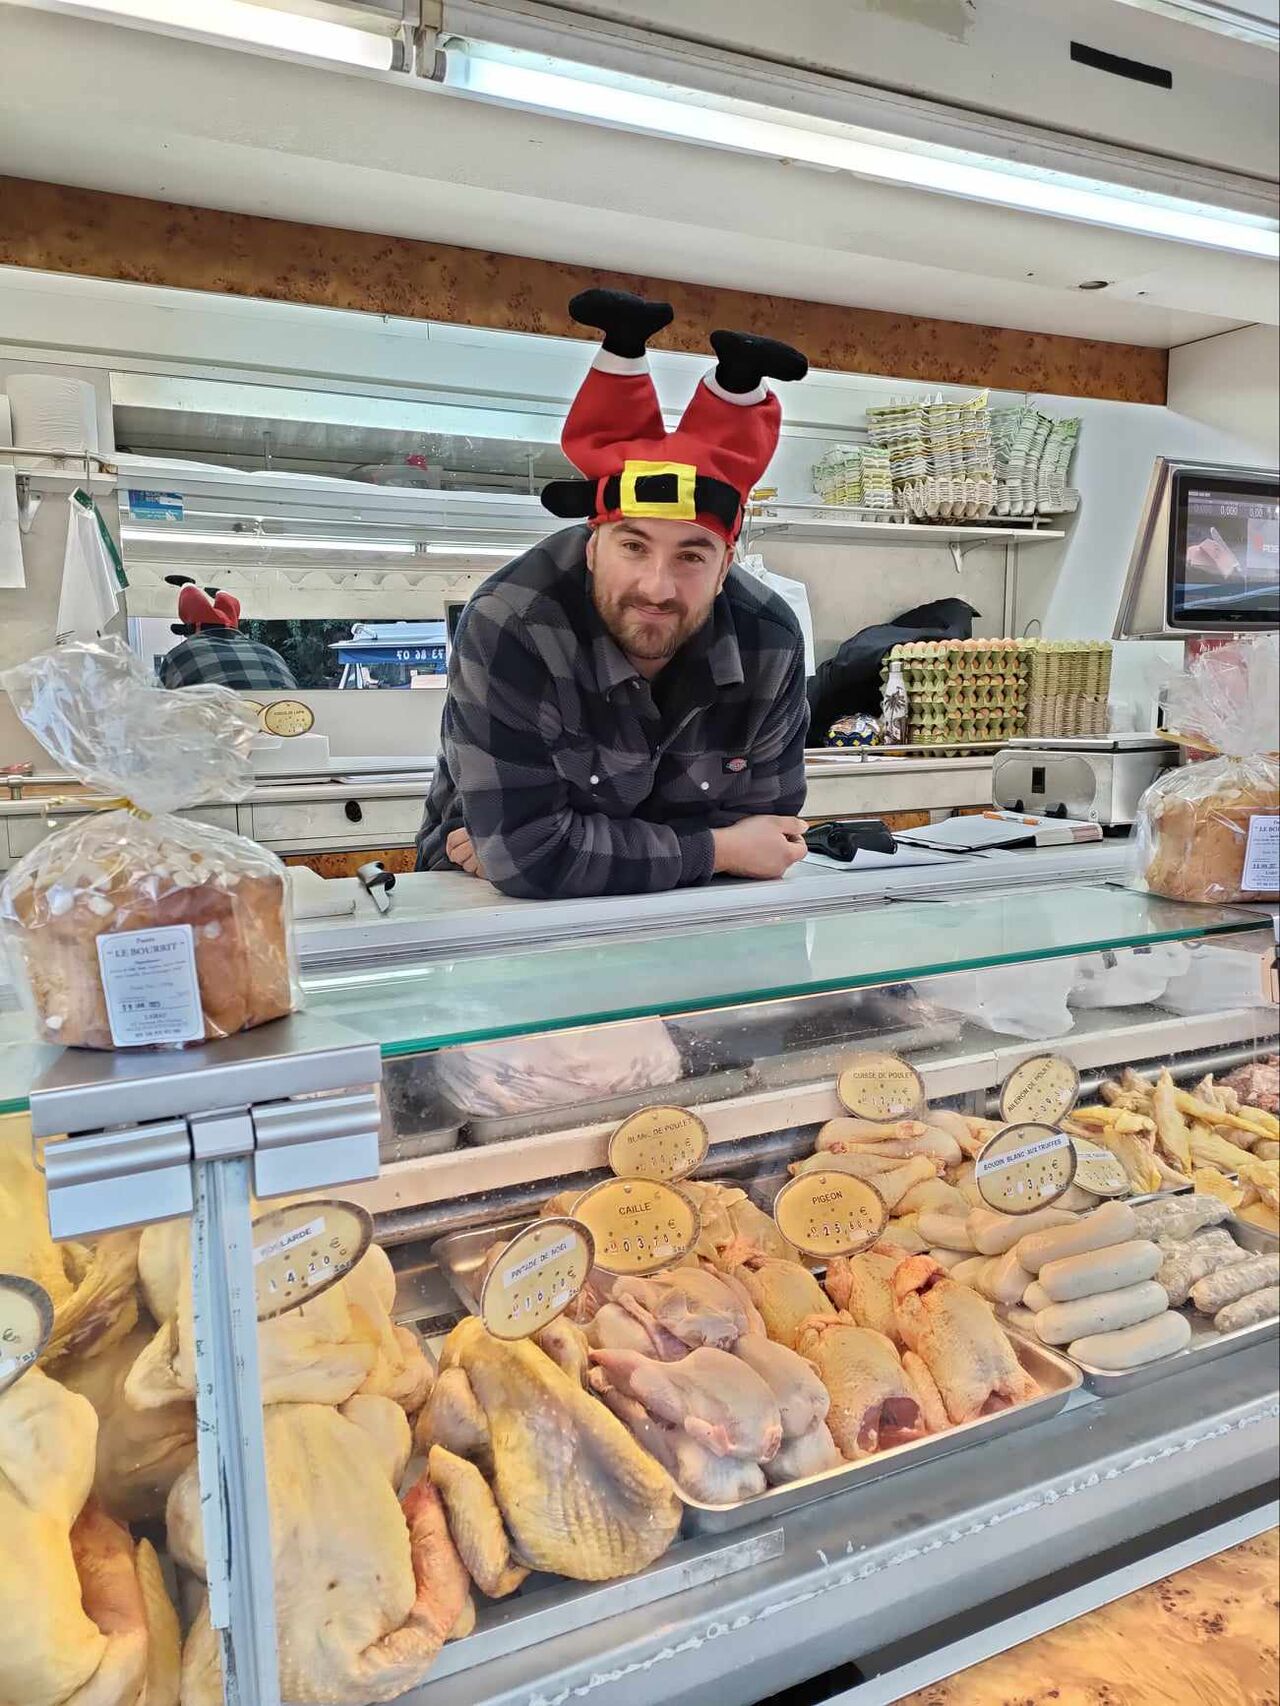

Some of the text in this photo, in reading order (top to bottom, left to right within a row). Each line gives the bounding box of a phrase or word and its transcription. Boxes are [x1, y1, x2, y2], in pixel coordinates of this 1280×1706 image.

[983, 1158, 1005, 1171] BOUDIN
[1006, 1151, 1025, 1163] BLANC
[1038, 1138, 1062, 1150] TRUFFES
[812, 1190, 843, 1205] PIGEON
[618, 1202, 652, 1216] CAILLE
[540, 1251, 550, 1262] DE
